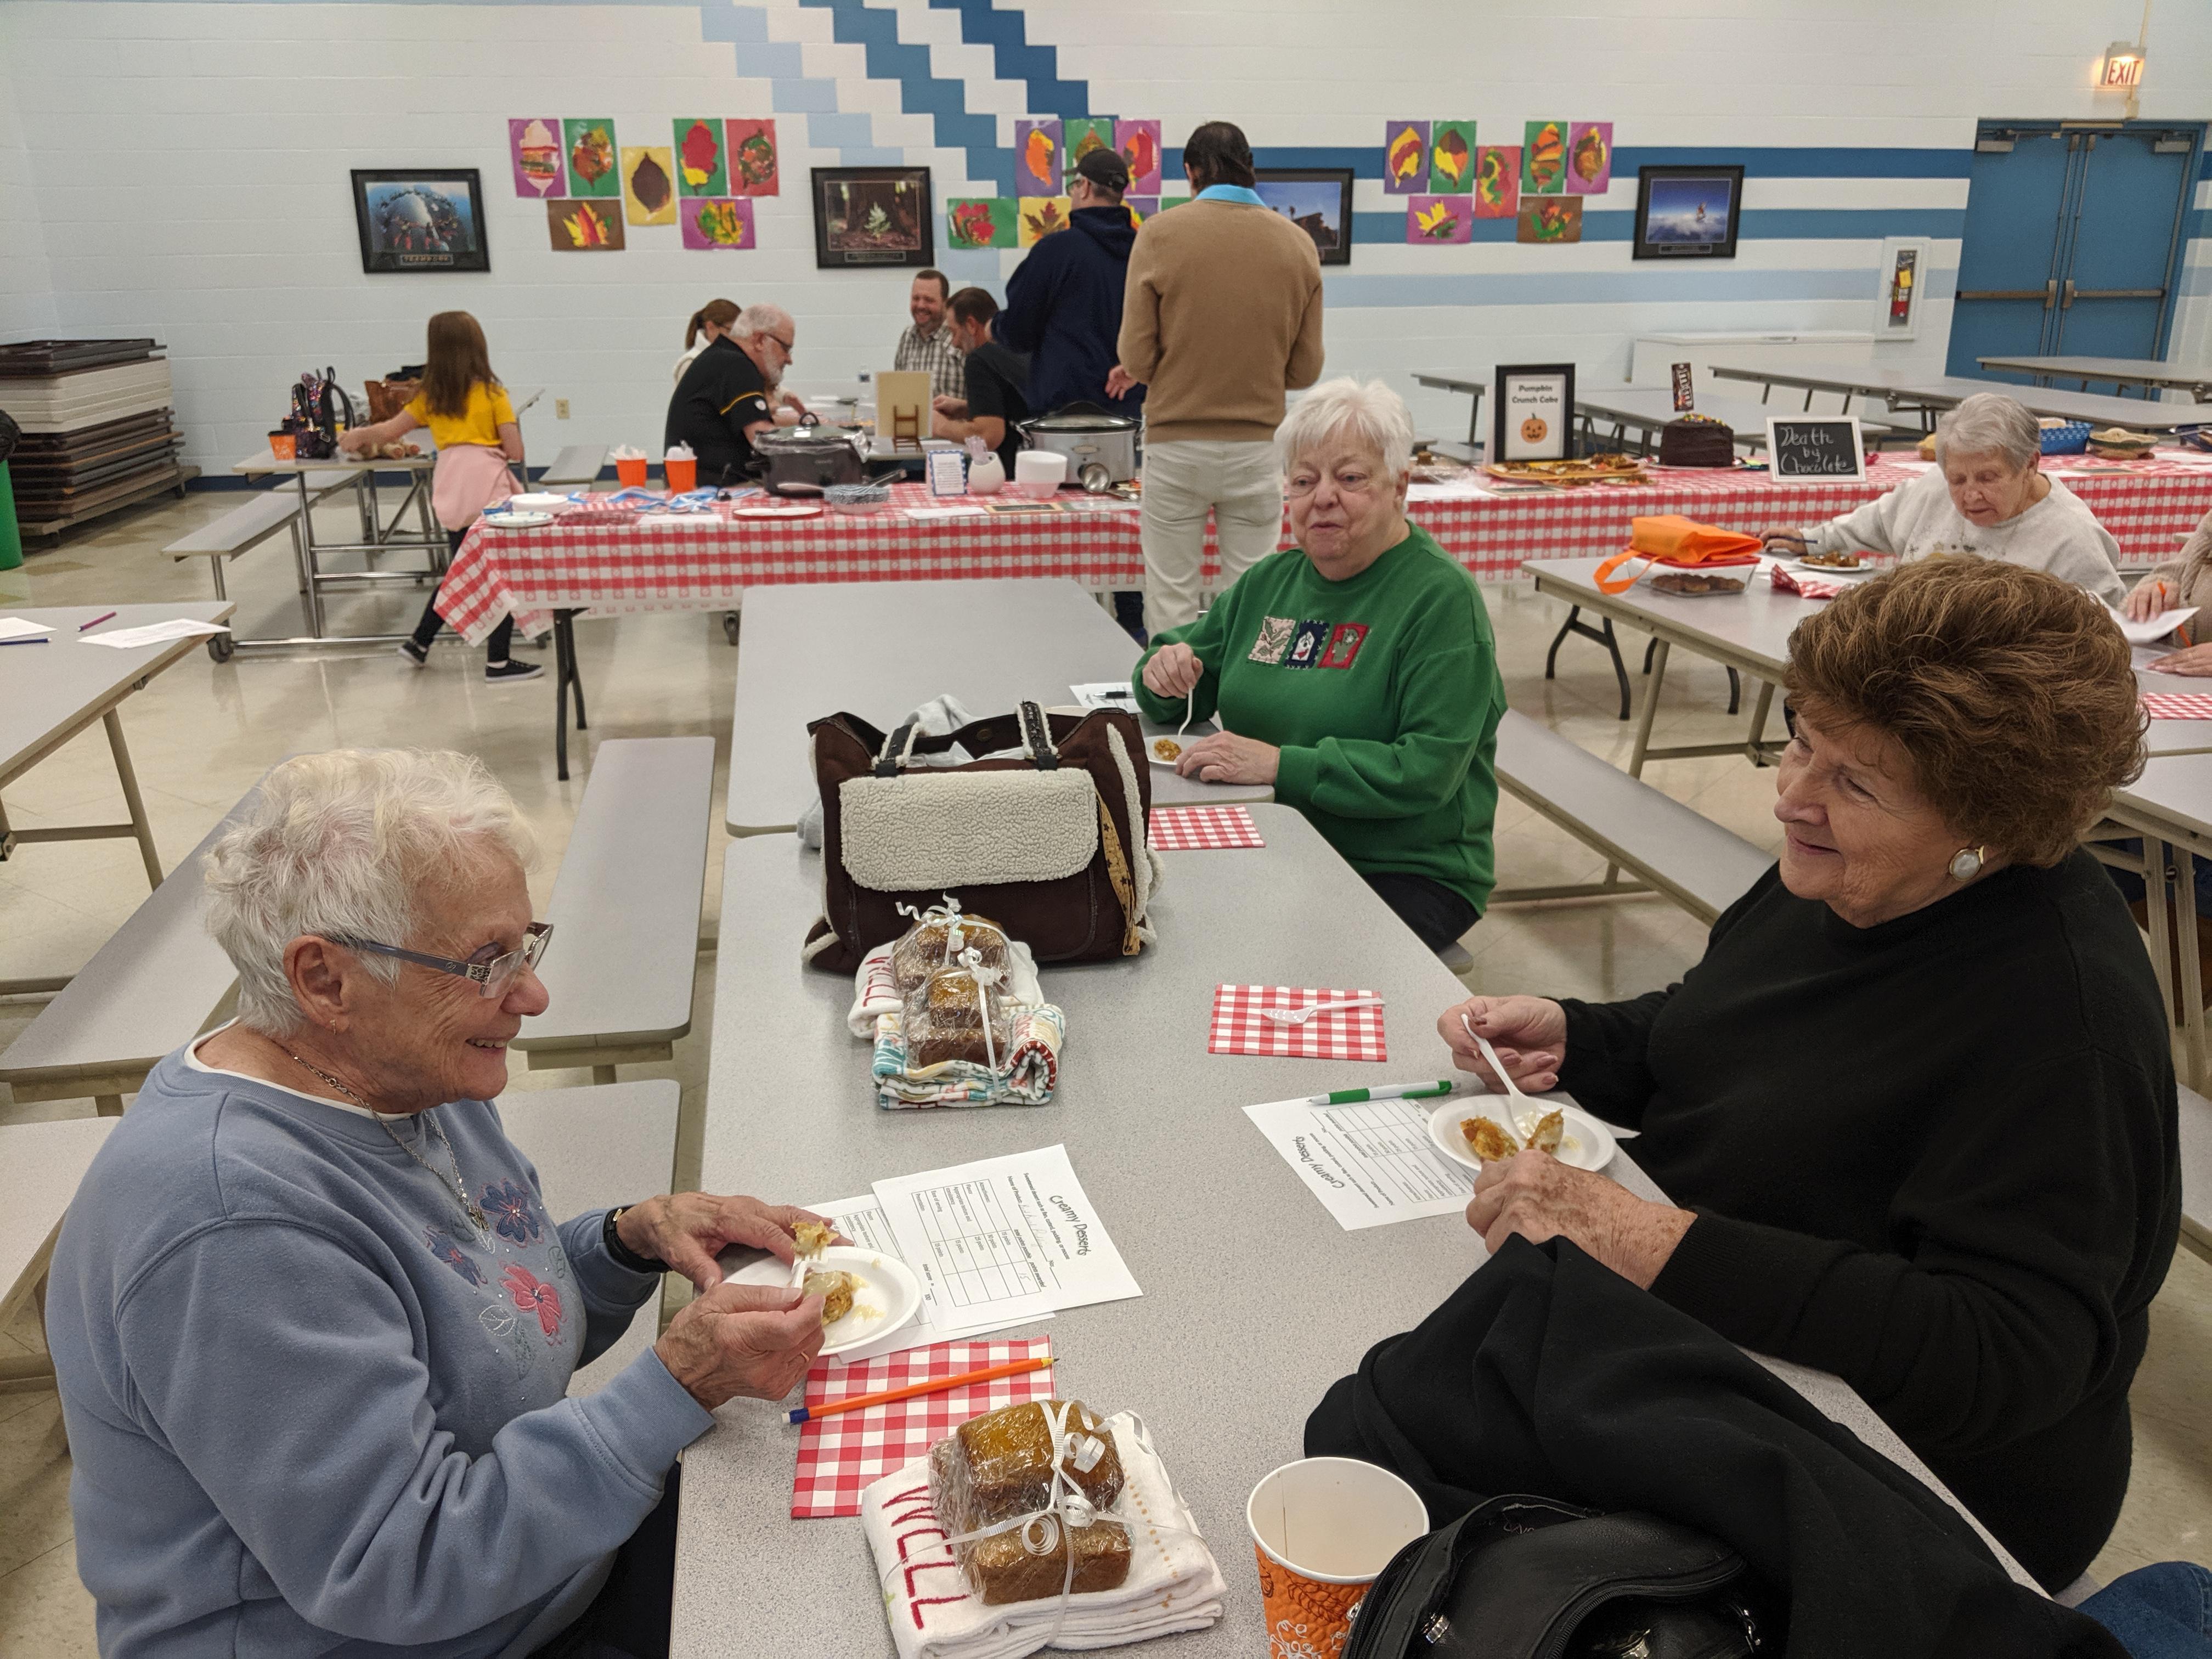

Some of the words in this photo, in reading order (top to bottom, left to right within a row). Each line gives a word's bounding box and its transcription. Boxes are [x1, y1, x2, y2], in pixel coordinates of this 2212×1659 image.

[2107, 60, 2140, 84] EXIT
[1779, 425, 1835, 447] Death
[1803, 446, 1821, 462] by
[1292, 1136, 1314, 1163] Desserts
[1308, 1164, 1345, 1188] Creamy
[1049, 1195, 1081, 1223] Creamy
[1074, 1223, 1092, 1256] Desserts
[1018, 1273, 1031, 1281] 15
